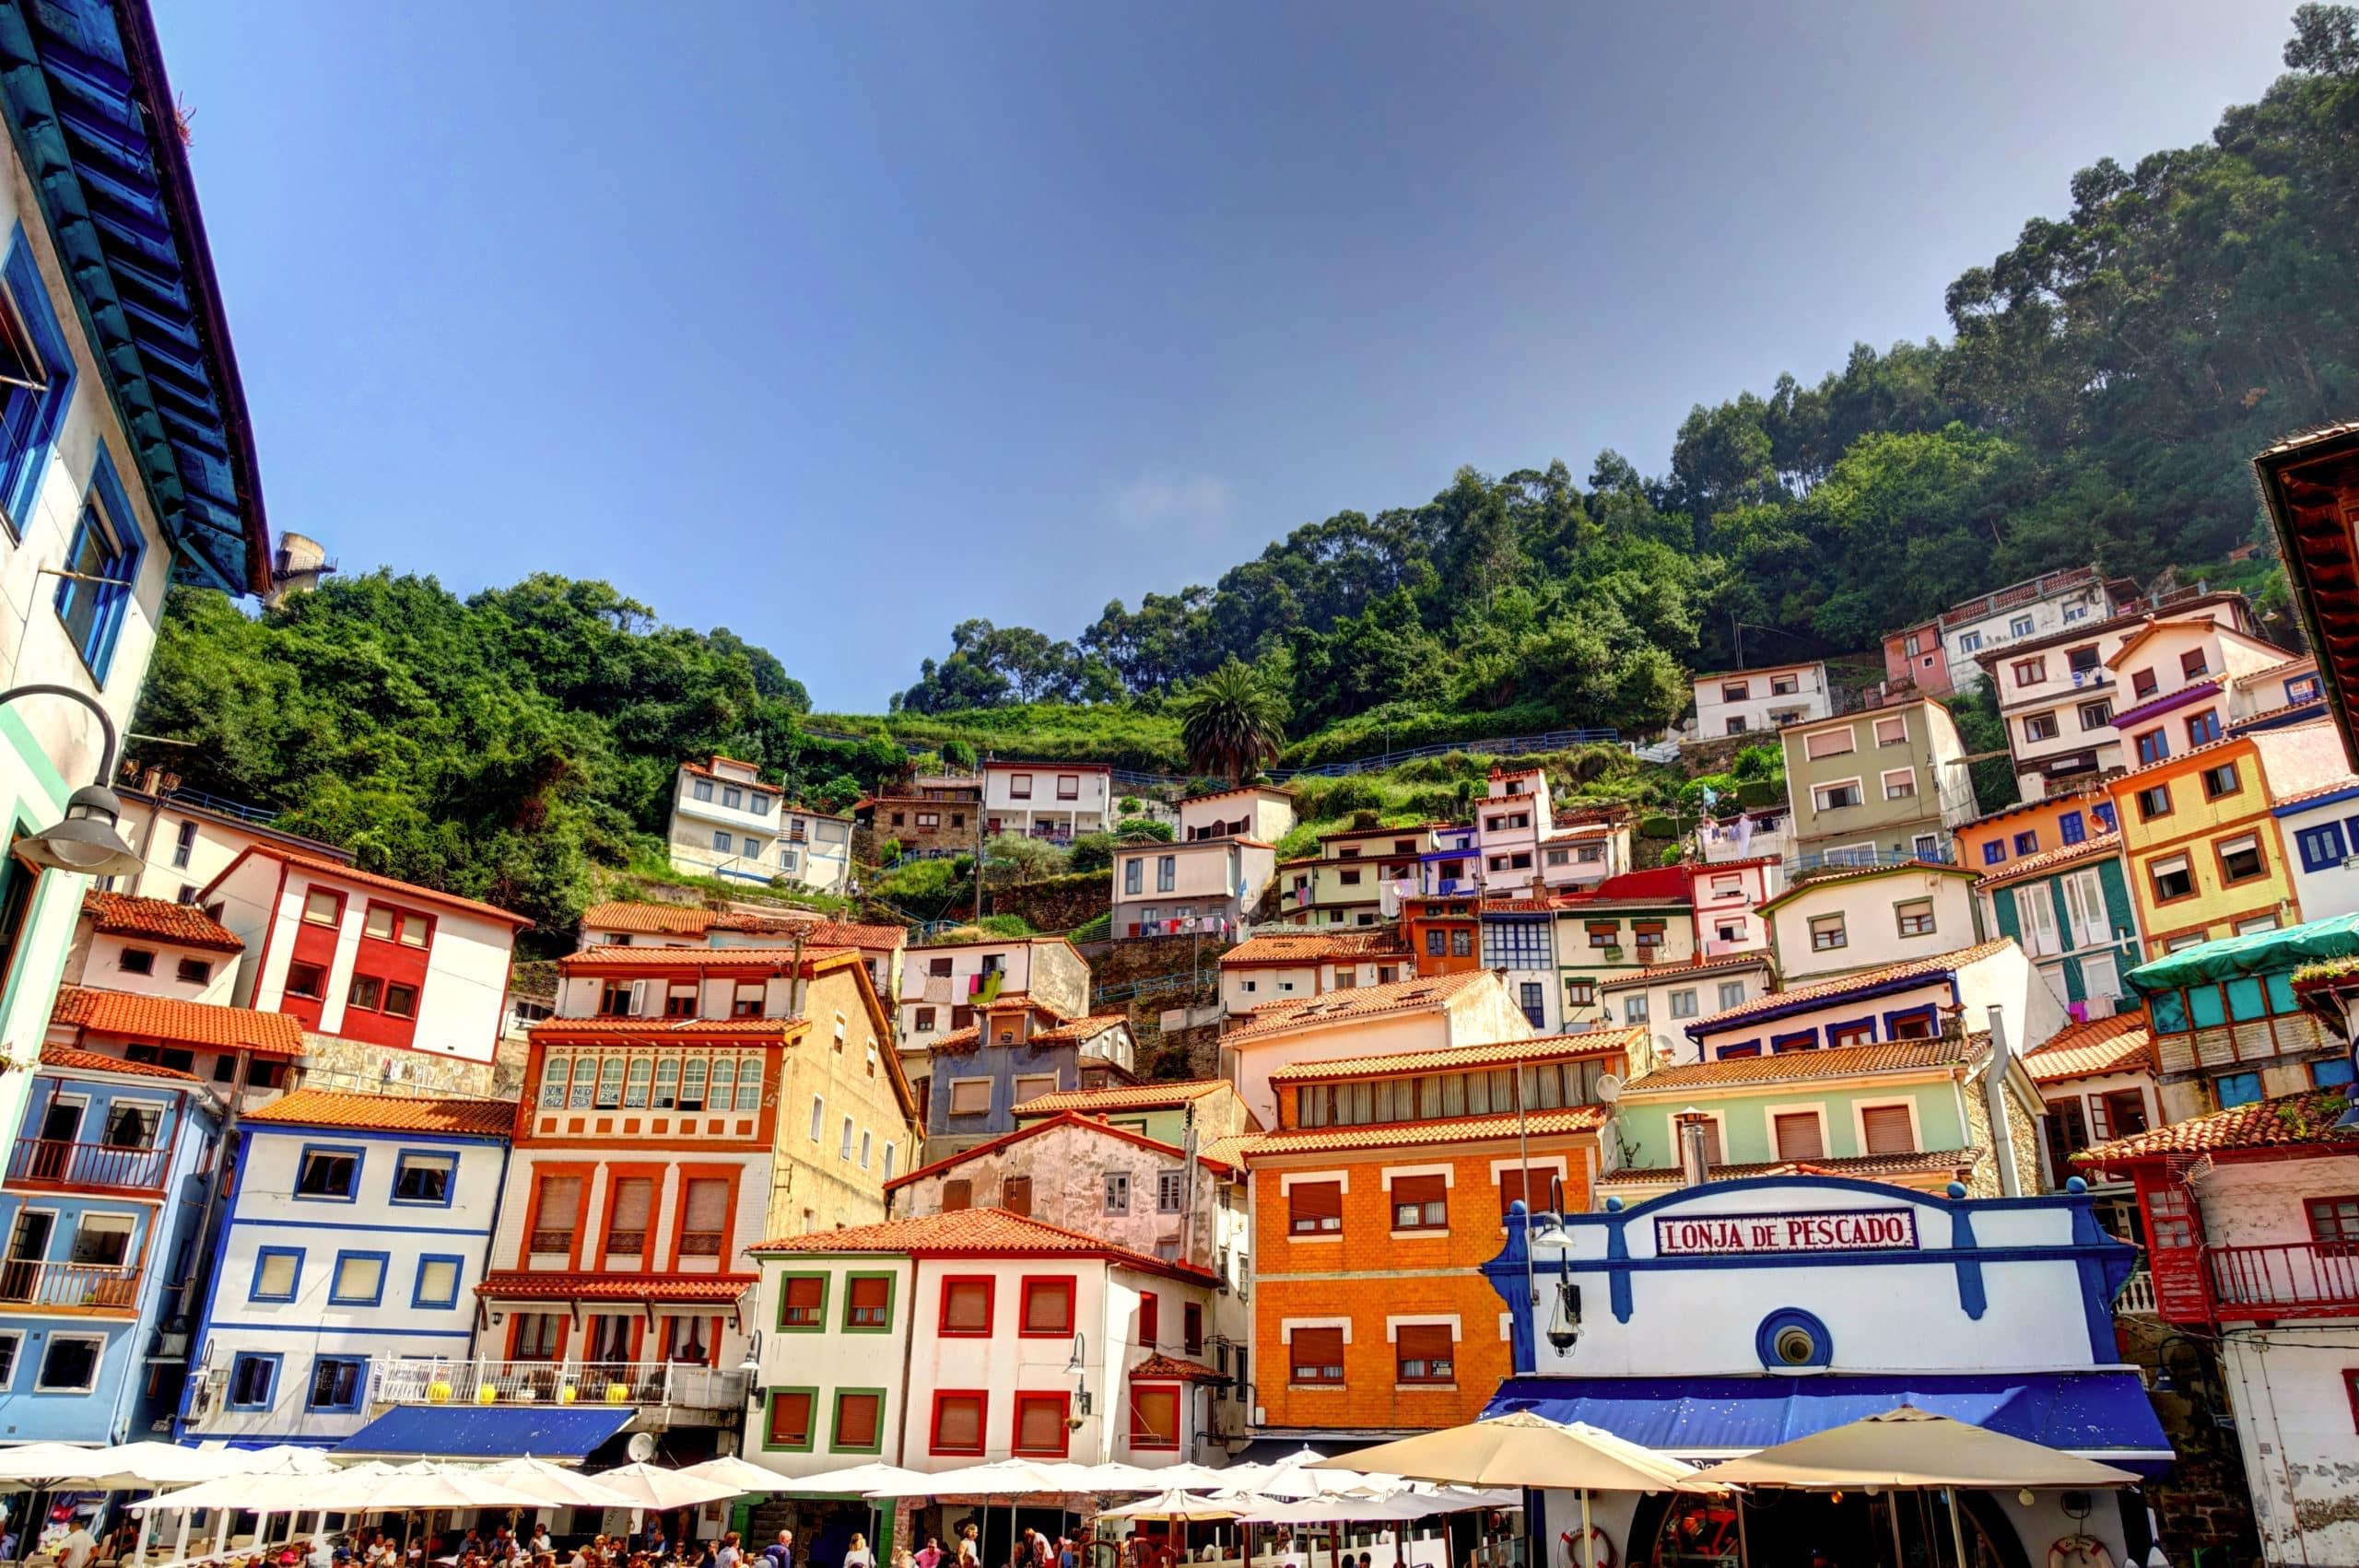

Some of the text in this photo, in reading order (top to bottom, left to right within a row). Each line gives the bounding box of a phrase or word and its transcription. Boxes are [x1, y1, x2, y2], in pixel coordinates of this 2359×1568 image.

[1665, 1217, 1904, 1249] LONJA DE PESCADO
